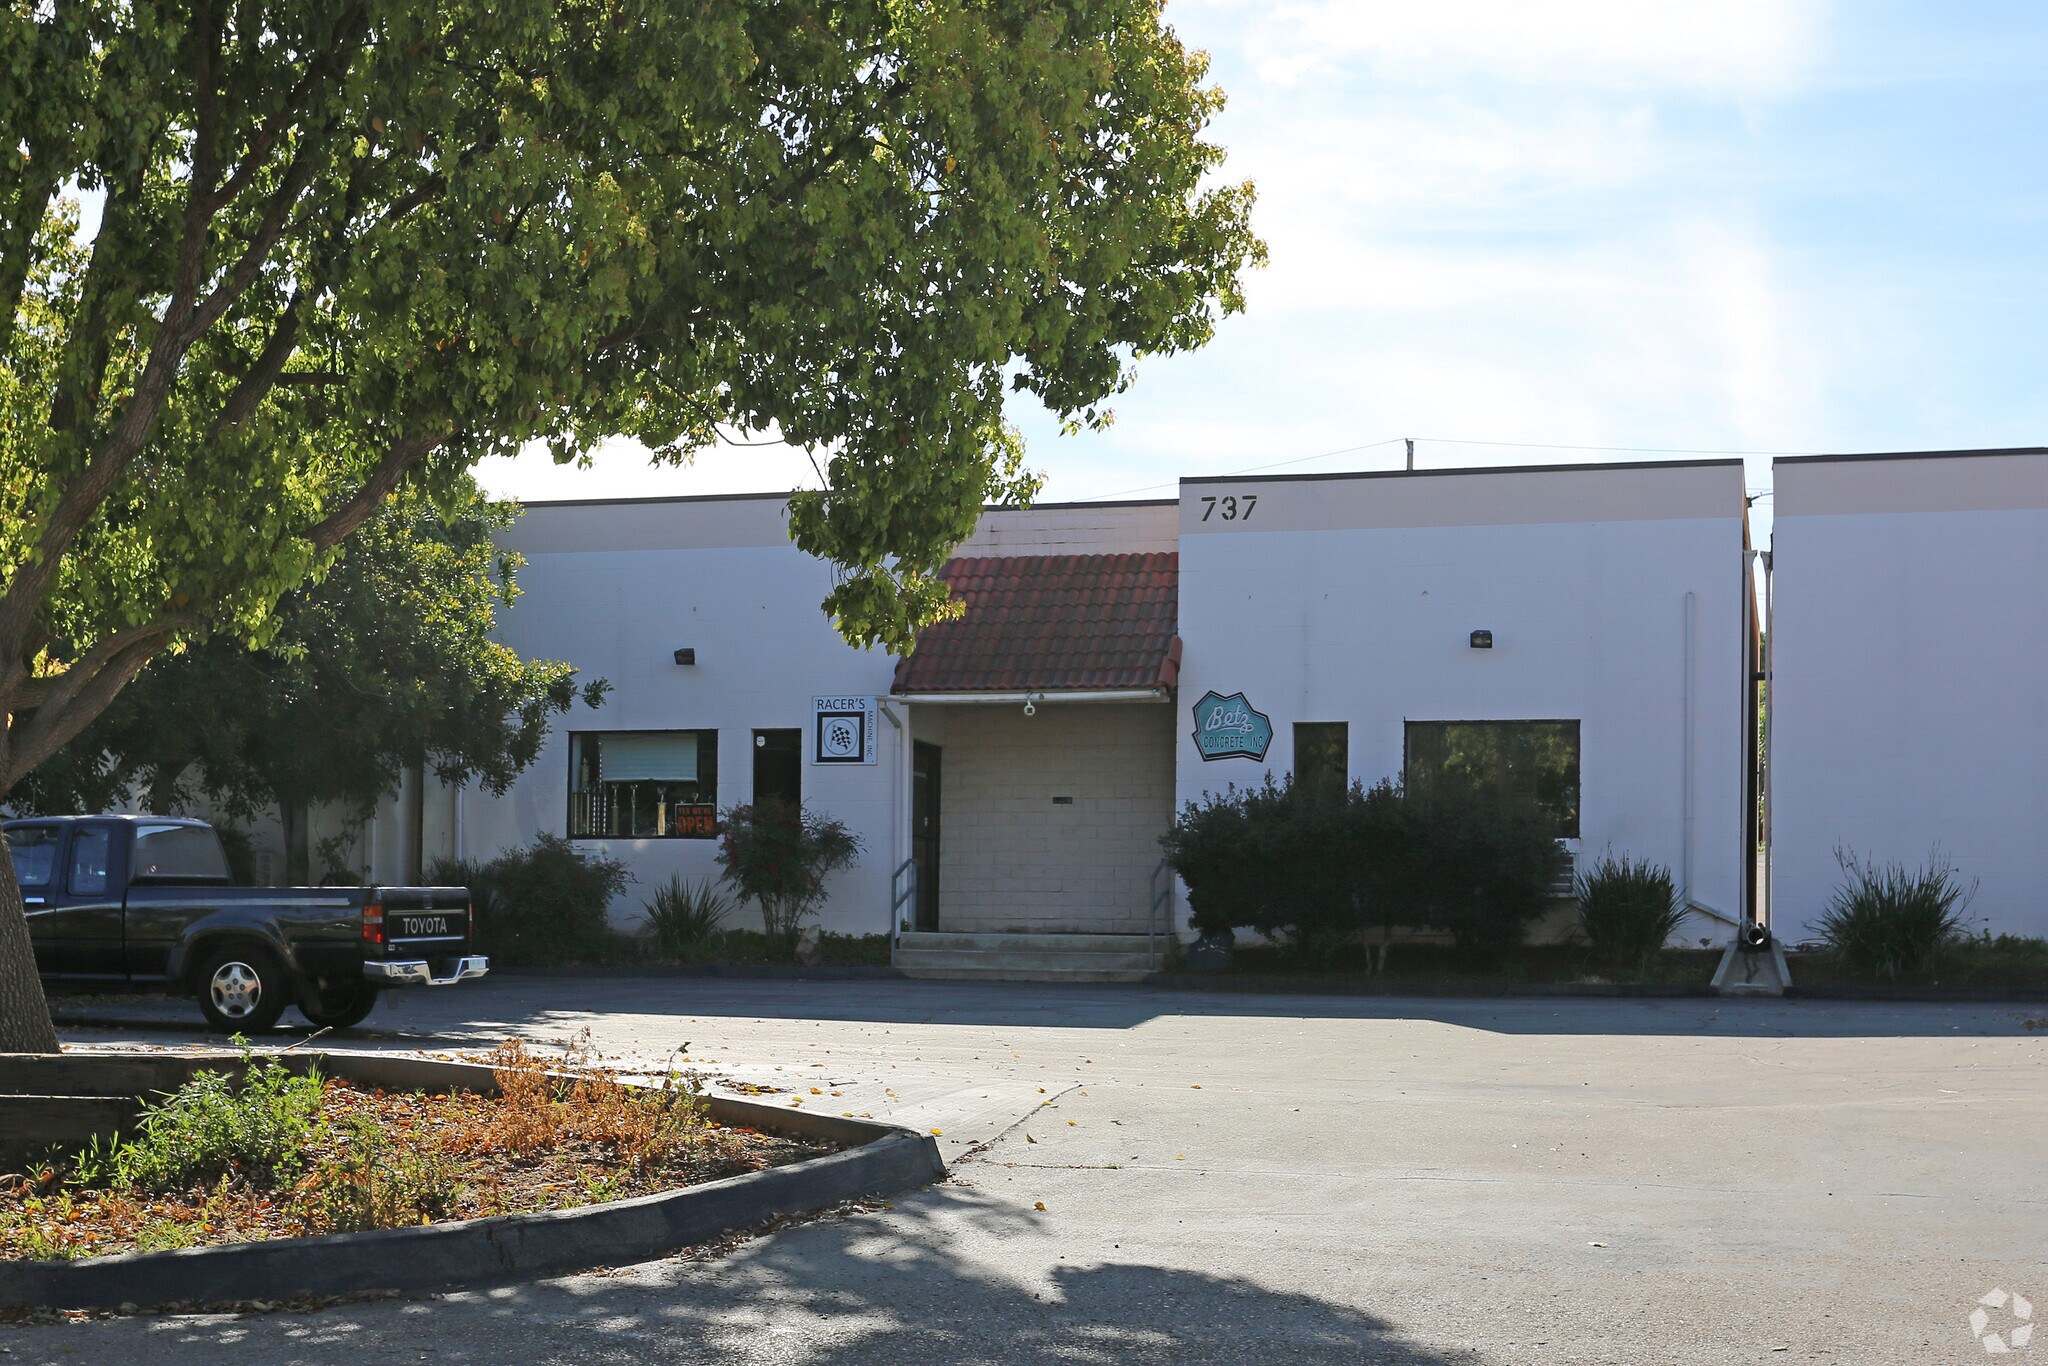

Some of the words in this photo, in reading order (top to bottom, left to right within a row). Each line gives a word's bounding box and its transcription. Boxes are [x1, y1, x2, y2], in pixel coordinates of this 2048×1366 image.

[1201, 495, 1257, 521] 737
[817, 698, 865, 710] RACER'S
[1205, 703, 1254, 735] Betz
[1203, 736, 1244, 748] CONCRETE
[1250, 736, 1264, 748] INC
[678, 815, 714, 833] OPEN
[403, 917, 447, 934] TOYOTA
